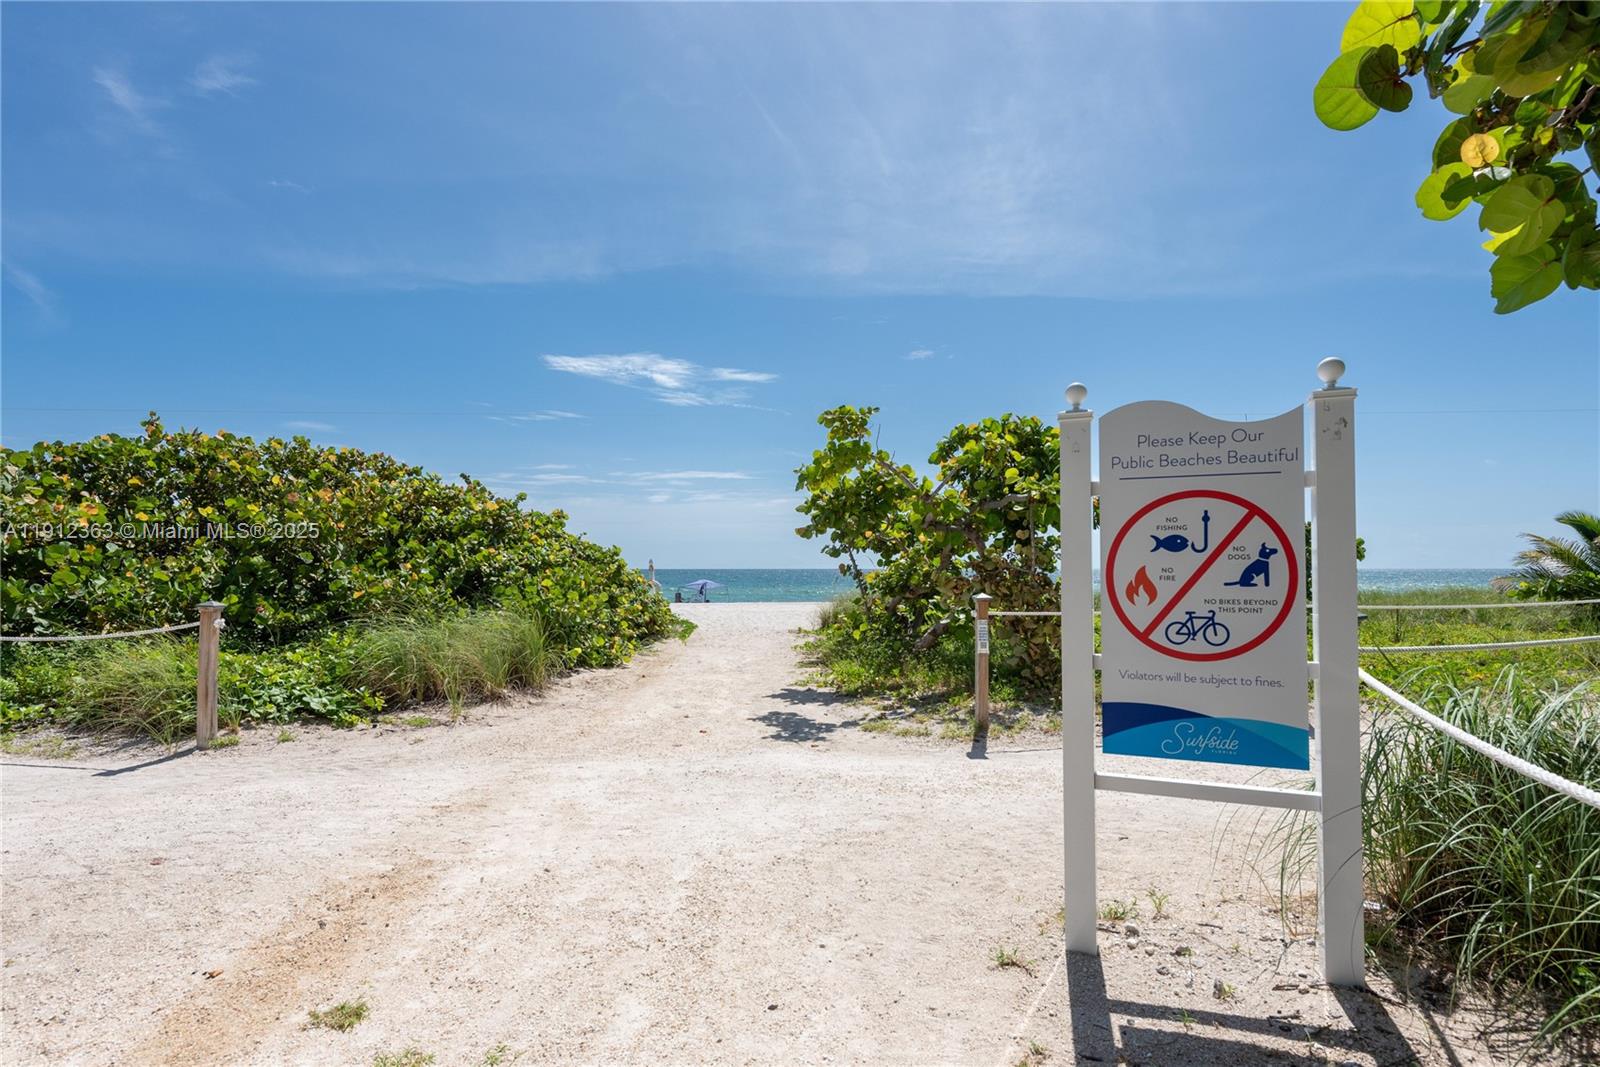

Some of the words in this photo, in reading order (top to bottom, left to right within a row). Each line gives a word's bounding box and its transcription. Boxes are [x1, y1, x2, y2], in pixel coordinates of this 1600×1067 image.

[1137, 435, 1184, 448] Please
[1189, 431, 1226, 447] Keep
[1231, 428, 1264, 443] Our
[1111, 454, 1154, 470] Public
[1159, 453, 1222, 468] Beaches
[1227, 448, 1299, 465] Beautiful
[1118, 668, 1163, 681] Violators
[1165, 672, 1182, 682] will
[1184, 673, 1197, 683] be
[1200, 674, 1238, 687] subject
[1241, 677, 1252, 686] to
[1255, 676, 1285, 688] fines.
[1161, 722, 1240, 755] Surfside
